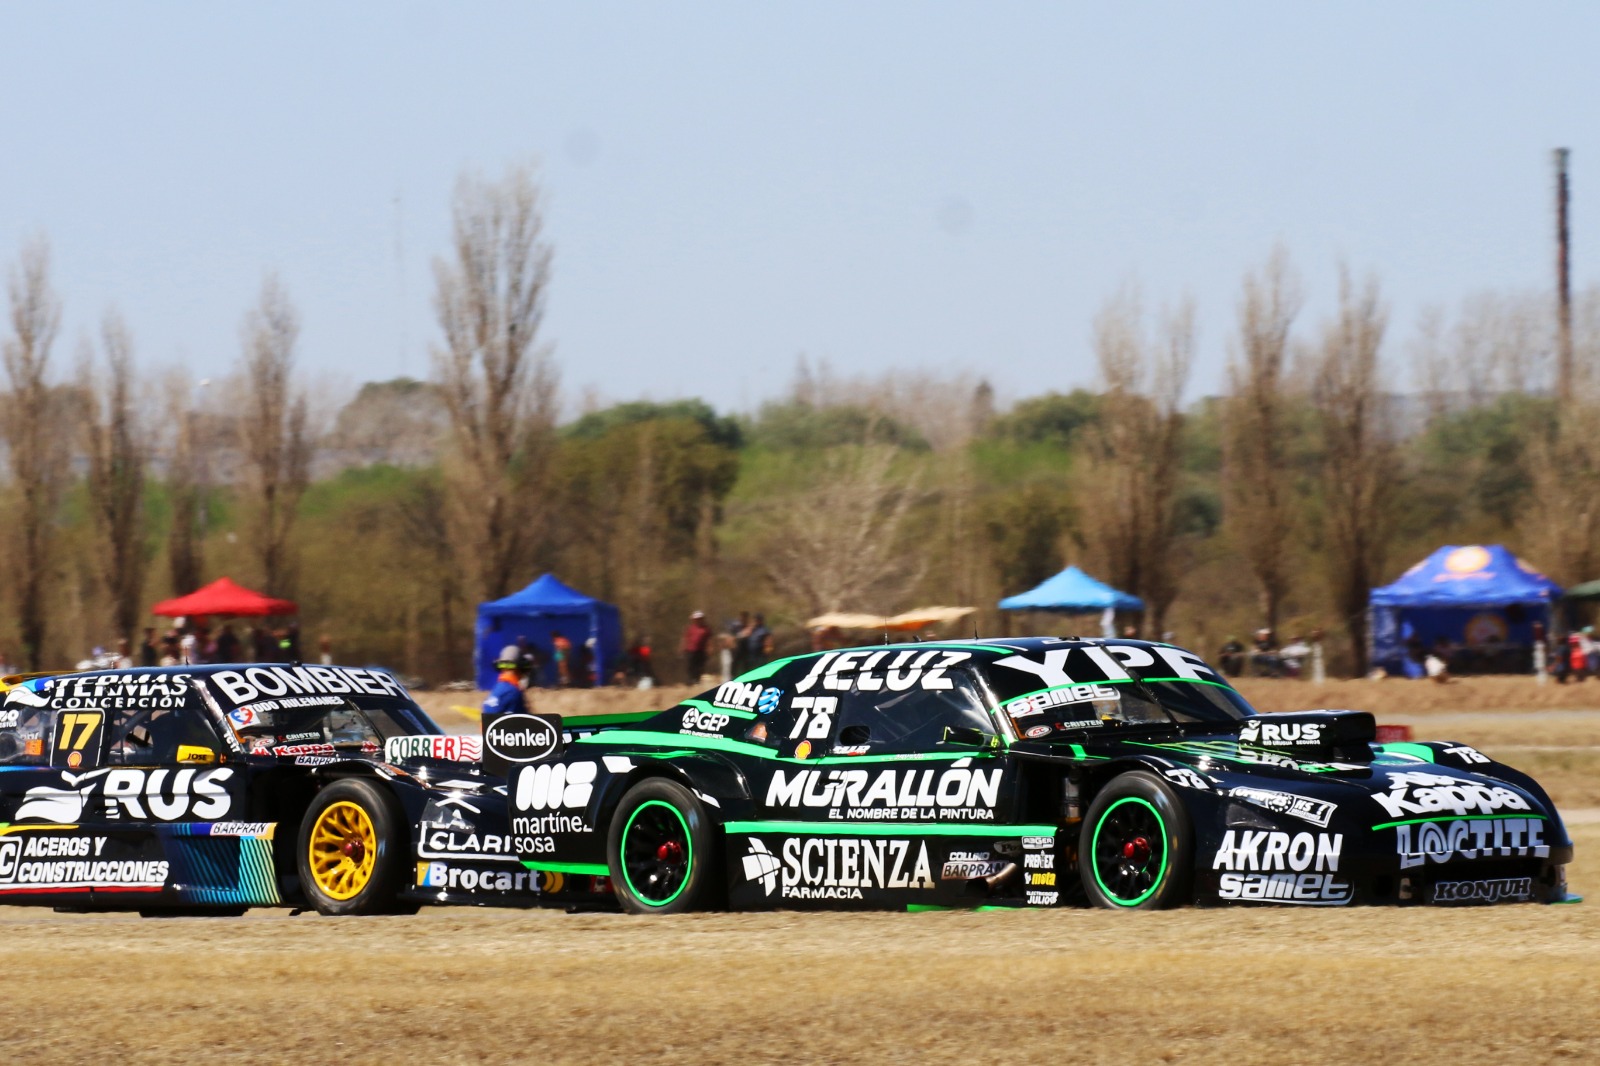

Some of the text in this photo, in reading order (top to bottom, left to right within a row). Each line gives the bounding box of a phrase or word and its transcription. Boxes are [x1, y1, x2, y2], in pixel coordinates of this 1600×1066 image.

[795, 651, 972, 694] JELUZ
[992, 645, 1215, 688] YPF
[54, 674, 192, 698] TERMAS
[211, 666, 404, 705] BOMBIER
[715, 681, 763, 708] MH
[50, 694, 187, 709] CONCEPCIÓN
[279, 695, 345, 709] RULEMANES
[696, 712, 730, 731] GEP
[788, 696, 838, 740] 78
[1063, 720, 1104, 729] CRISTEM
[58, 713, 102, 750] 17
[492, 728, 550, 746] Henkel
[1261, 723, 1321, 741] RUS
[273, 743, 335, 757] Kappa
[390, 737, 456, 762] CORRER
[103, 767, 234, 821] RUS
[765, 757, 1003, 808] MURALLÓN
[1371, 786, 1531, 818] Kappa
[829, 809, 995, 820] EL NOMBRE DE LA PINTURA
[213, 823, 266, 834] BARPRAN
[24, 837, 107, 857] ACEROS Y
[429, 831, 513, 853] CLARI
[515, 835, 556, 853] sosa
[1212, 830, 1344, 872] AKRON
[1396, 818, 1550, 870] LOCTITE
[18, 860, 169, 883] CONSTRUCCIONES
[782, 838, 935, 889] SCIENZA
[430, 862, 541, 891] Brocart
[781, 886, 863, 899] FARMACIA
[1434, 878, 1531, 902] KONJUH
